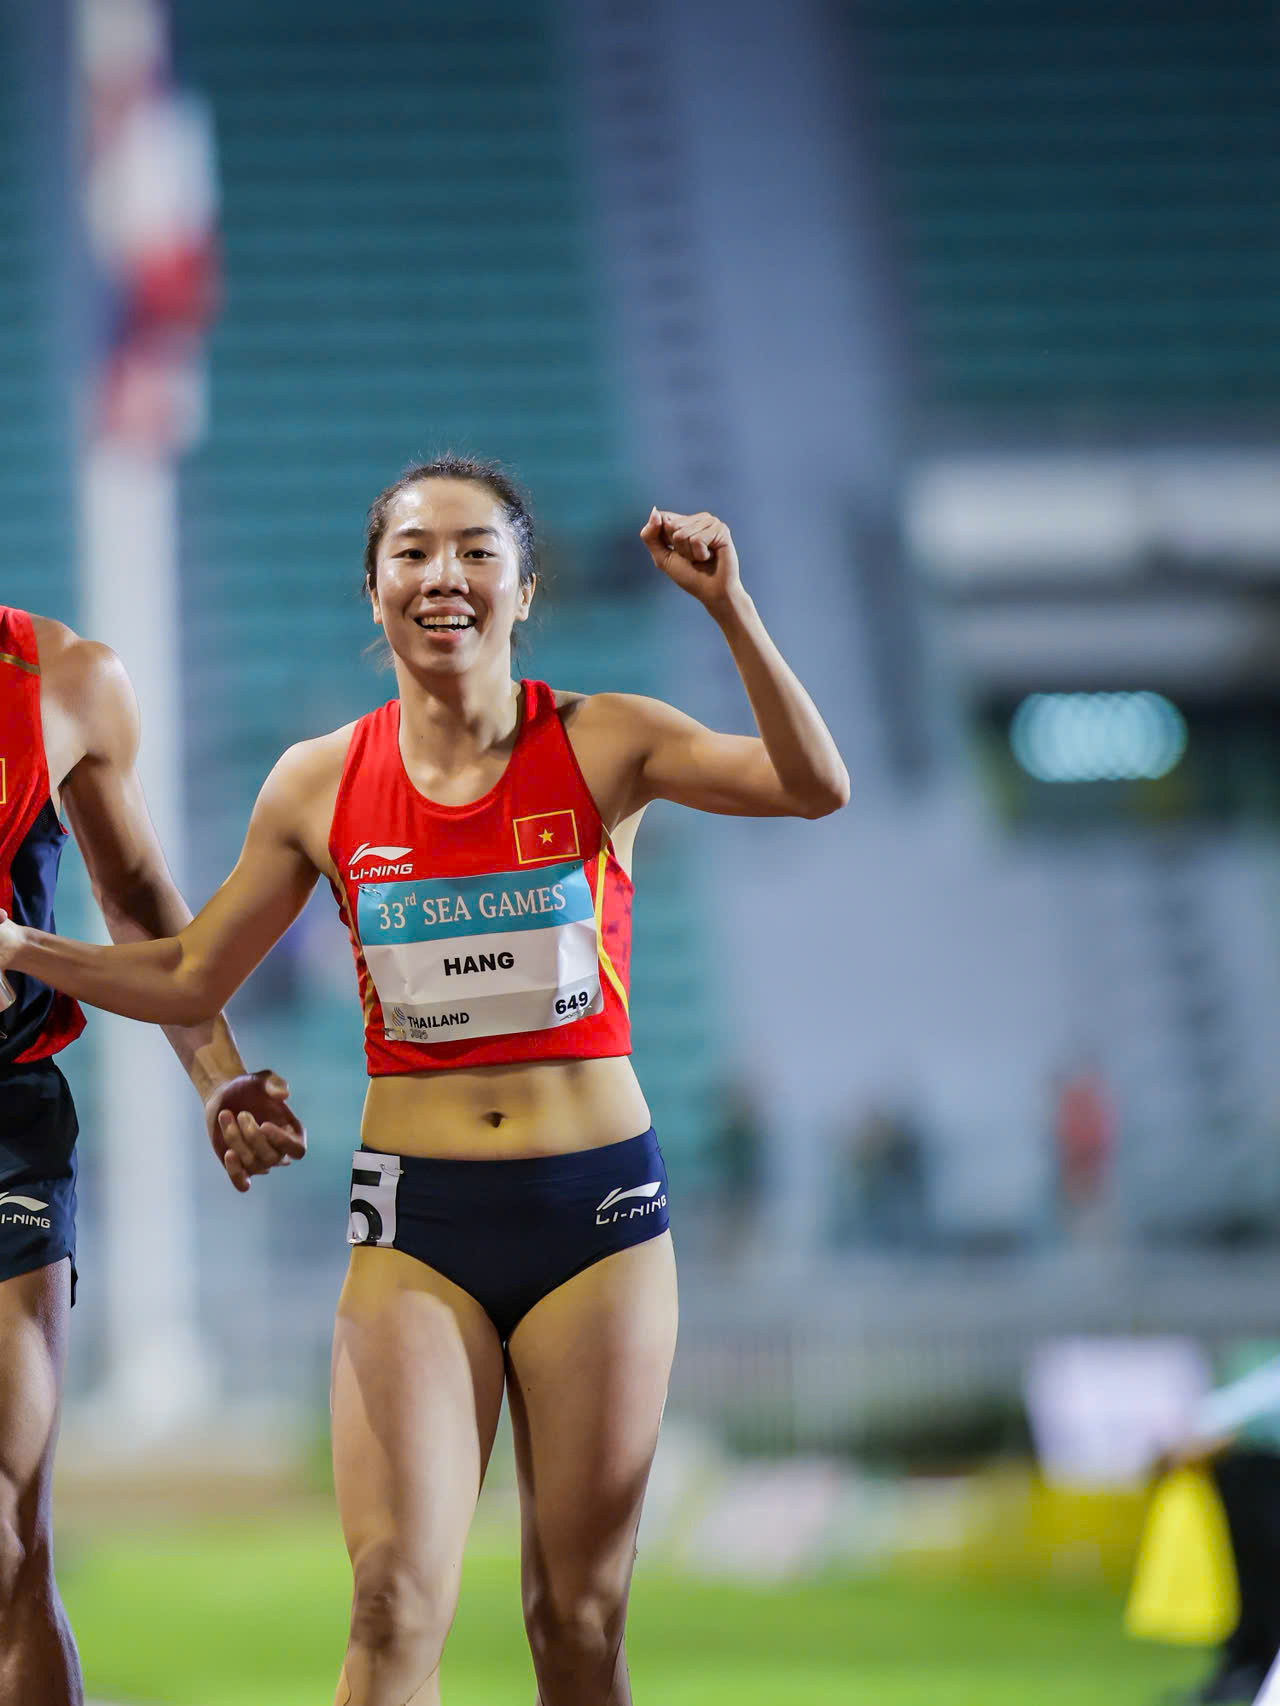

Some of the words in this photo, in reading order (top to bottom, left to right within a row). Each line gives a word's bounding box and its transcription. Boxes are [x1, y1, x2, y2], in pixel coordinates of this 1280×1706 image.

[350, 863, 413, 881] LI-NING
[423, 895, 472, 926] SEA
[479, 883, 567, 918] GAMES
[444, 952, 515, 976] HANG
[555, 991, 588, 1015] 649
[407, 1012, 470, 1028] THAILAND
[596, 1195, 667, 1225] LI-NING
